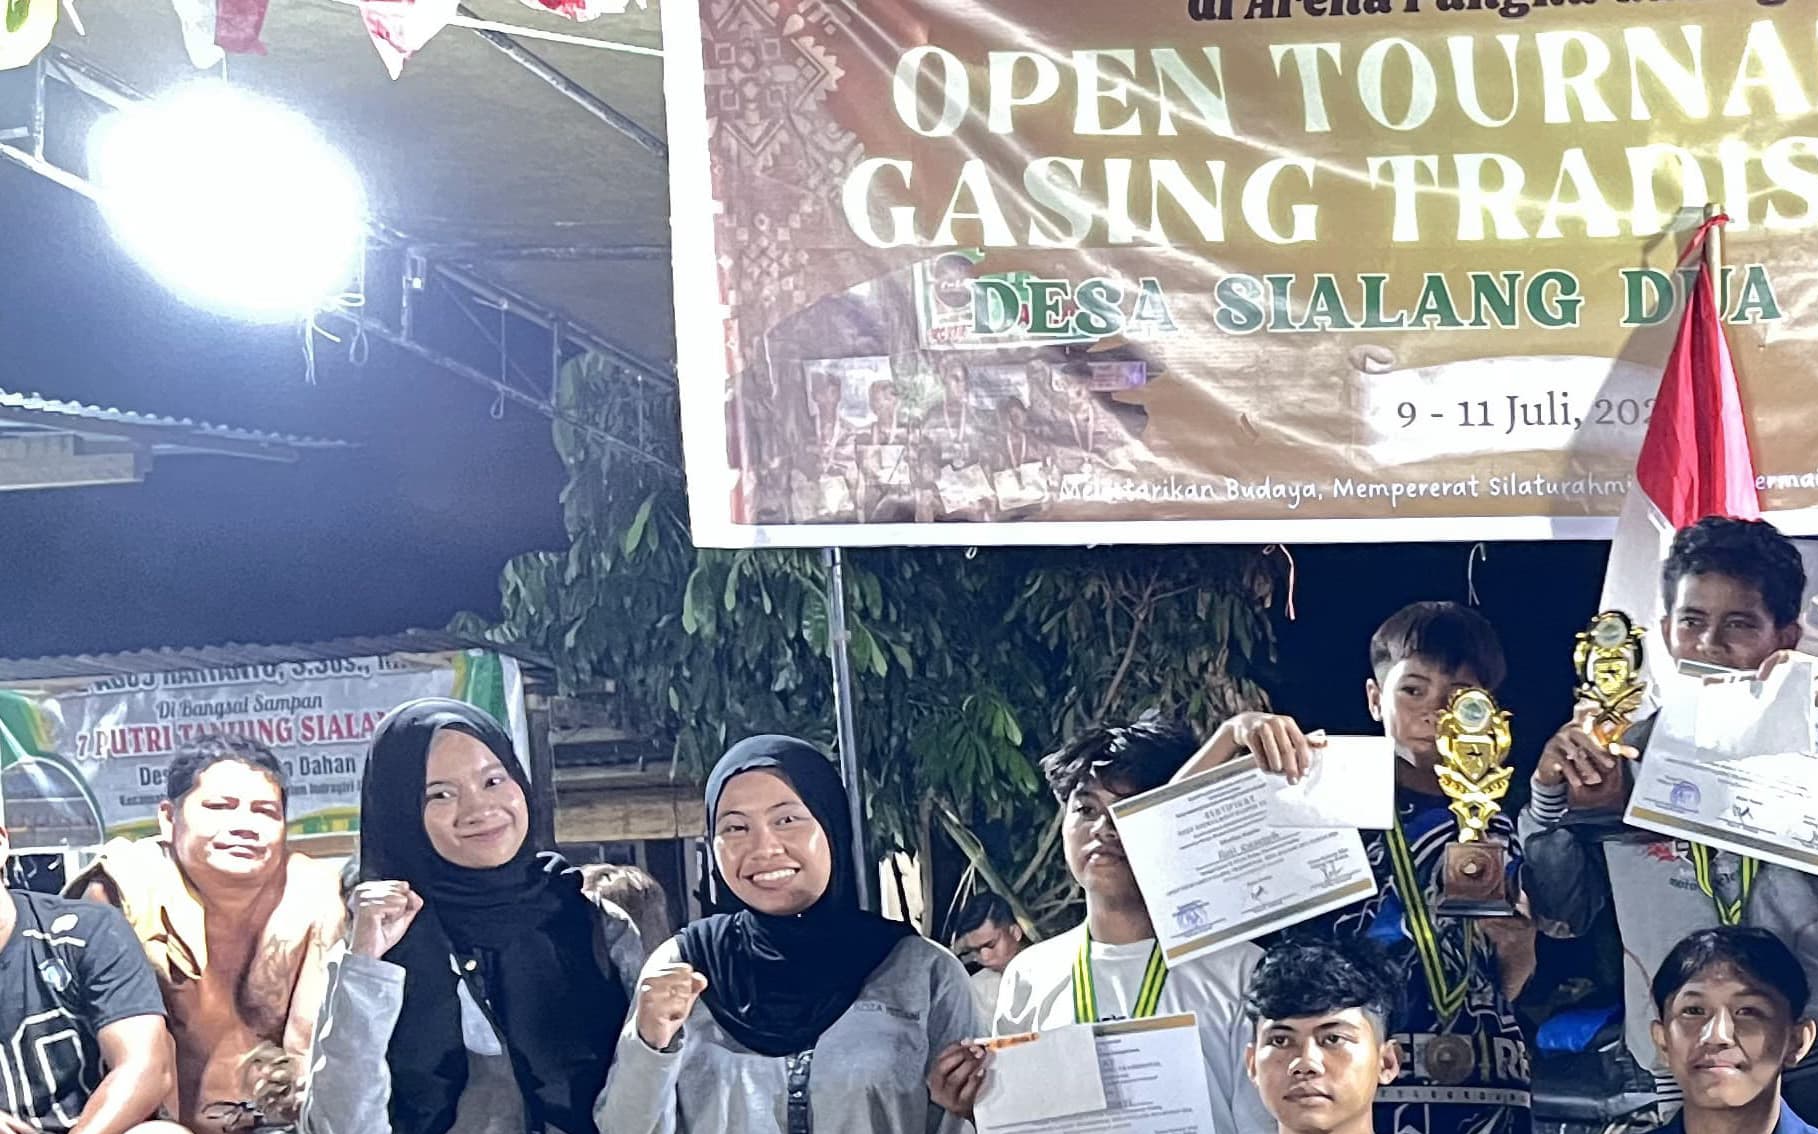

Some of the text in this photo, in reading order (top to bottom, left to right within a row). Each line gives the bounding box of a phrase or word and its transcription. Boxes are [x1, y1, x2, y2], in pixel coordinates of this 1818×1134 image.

[892, 44, 1235, 138] OPEN
[842, 156, 1318, 248] GASING
[968, 276, 1180, 336] DESA
[1214, 268, 1583, 334] SIALANG
[1397, 401, 1417, 429] 9
[1457, 399, 1495, 427] 11
[1504, 390, 1582, 435] Juli,
[1227, 476, 1323, 510] Budaya,
[1332, 476, 1480, 509] Mempererat
[157, 694, 323, 720] Di Bangsal Sampan
[78, 734, 90, 757] 7
[94, 724, 173, 757] PUTRI
[299, 756, 357, 777] Dahan
